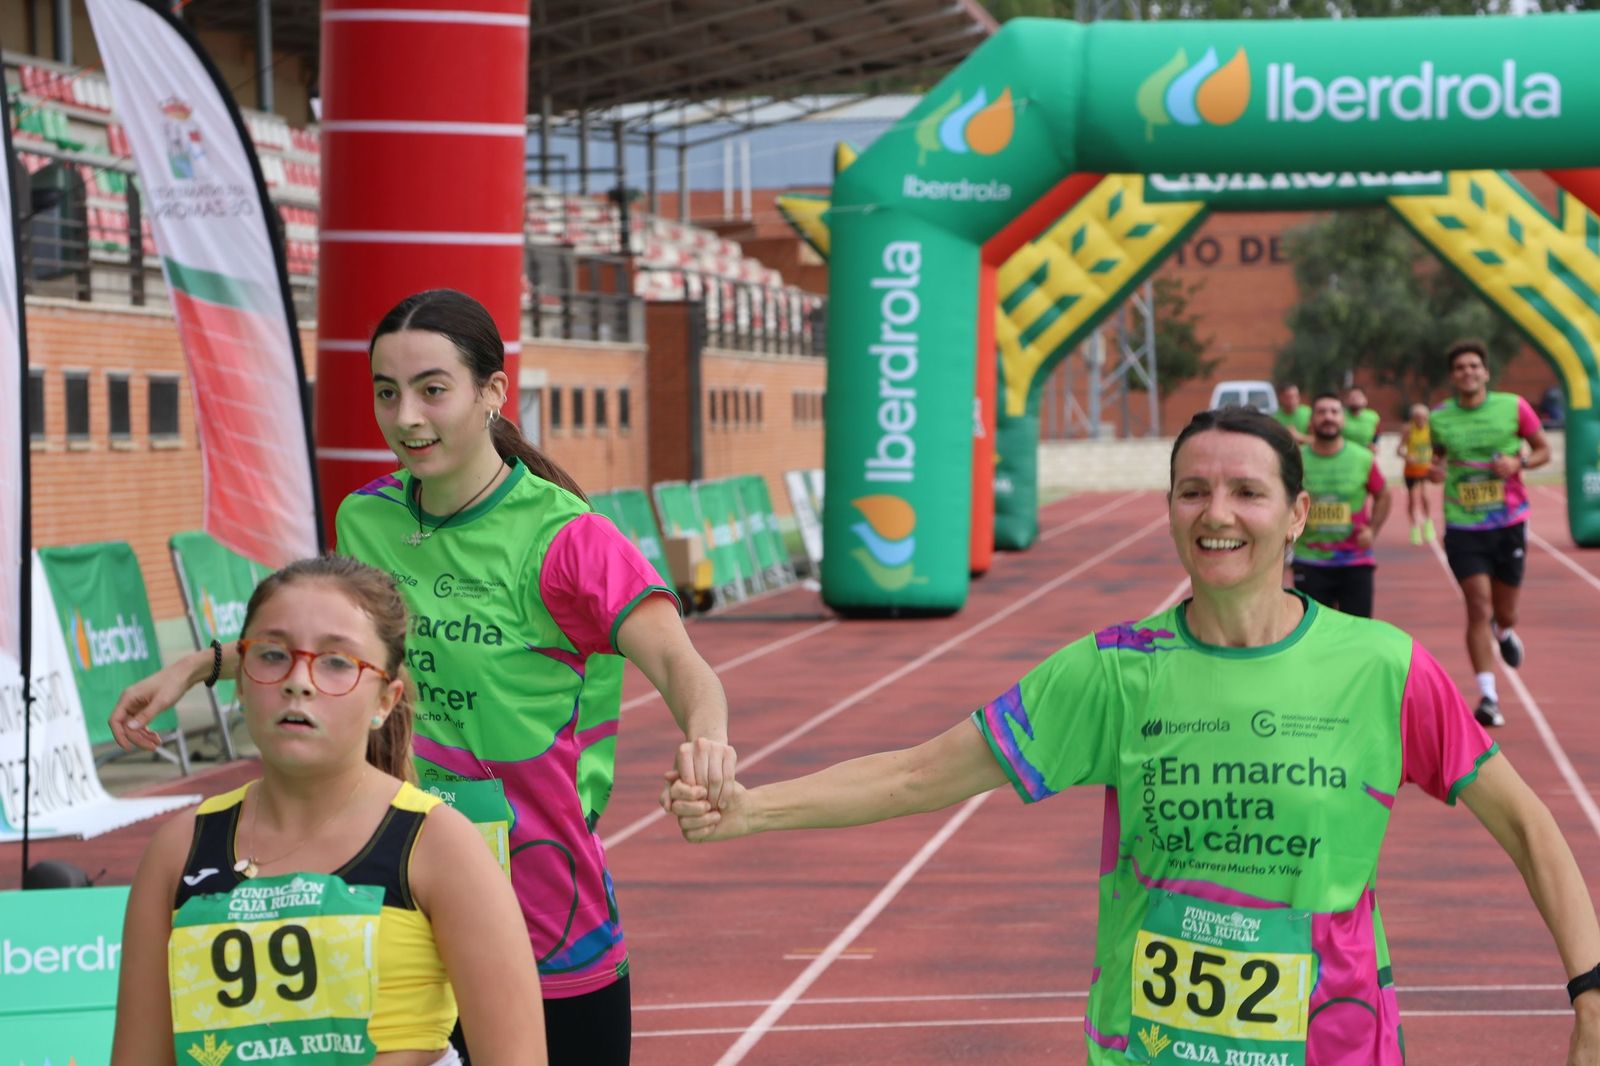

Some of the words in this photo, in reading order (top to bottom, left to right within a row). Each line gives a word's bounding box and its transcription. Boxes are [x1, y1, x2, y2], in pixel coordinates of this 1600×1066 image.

[1266, 59, 1562, 122] Iberdrola
[902, 174, 1012, 202] Iberdrola
[864, 240, 923, 483] Iberdrola
[1165, 718, 1230, 735] Iberdrola
[1160, 756, 1200, 786] En
[1212, 757, 1347, 789] marcha
[1141, 758, 1165, 853] ZAMORA
[1159, 792, 1275, 821] contra
[1167, 827, 1194, 852] el
[1204, 824, 1322, 859] cáncer
[1188, 860, 1227, 873] Carrera
[1228, 863, 1265, 875] Mucho
[1268, 865, 1277, 875] X
[1279, 865, 1303, 877] Vivir
[229, 897, 268, 912] CAJA
[271, 892, 321, 908] RURAL
[1181, 918, 1212, 936] CAJA
[1215, 925, 1260, 943] RURAL
[211, 924, 318, 1009] 99
[1142, 940, 1281, 1024] 352
[236, 1037, 297, 1061] CAJA
[301, 1032, 365, 1055] RURAL
[1172, 1040, 1220, 1065] CAJA
[1224, 1049, 1294, 1066] RURAL
